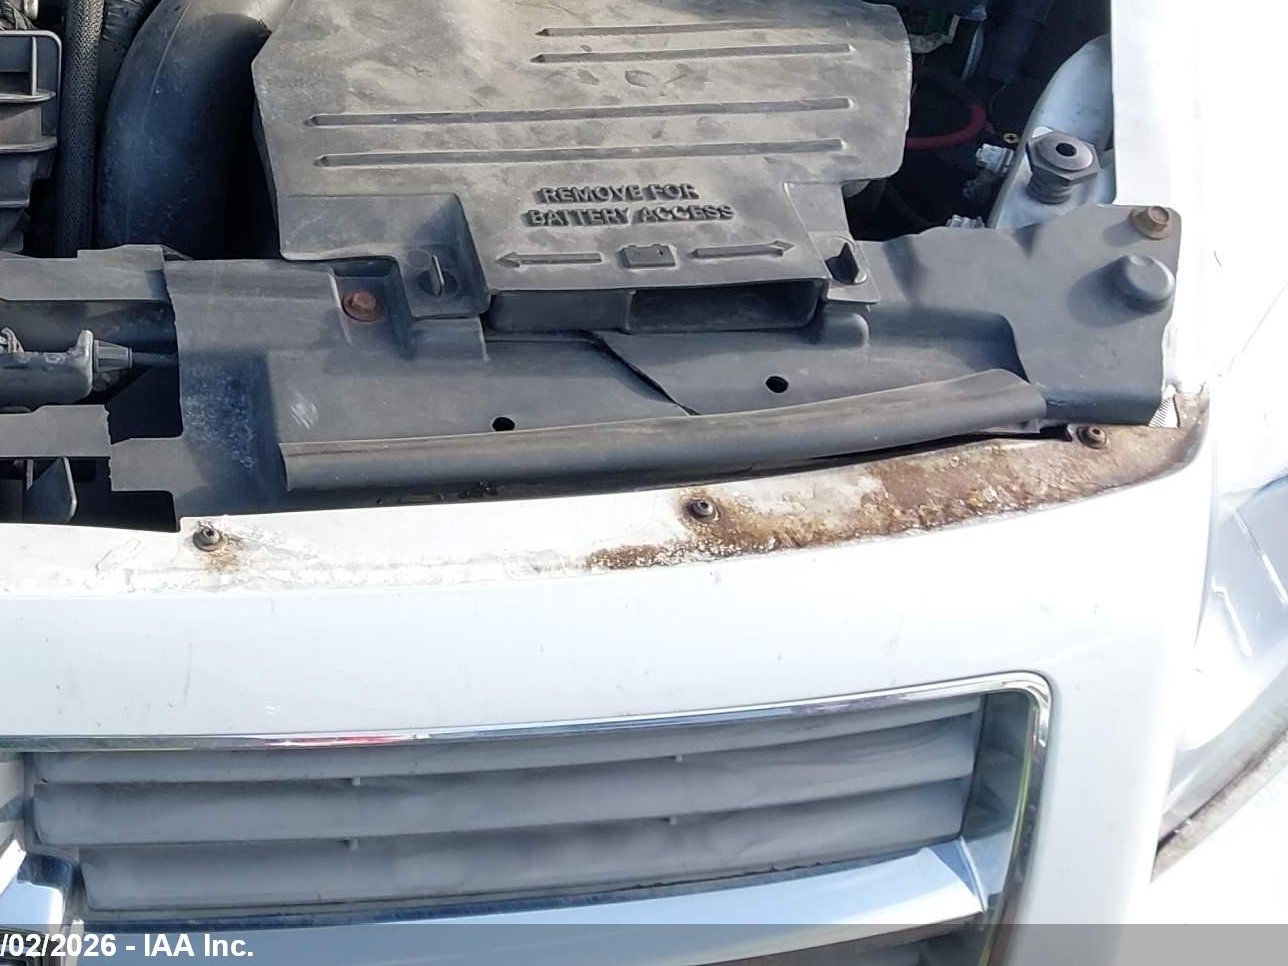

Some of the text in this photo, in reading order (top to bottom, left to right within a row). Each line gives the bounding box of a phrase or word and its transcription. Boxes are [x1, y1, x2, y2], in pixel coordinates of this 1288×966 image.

[536, 184, 700, 204] REMOVE FOR
[522, 204, 736, 227] BATTERY ACCESS
